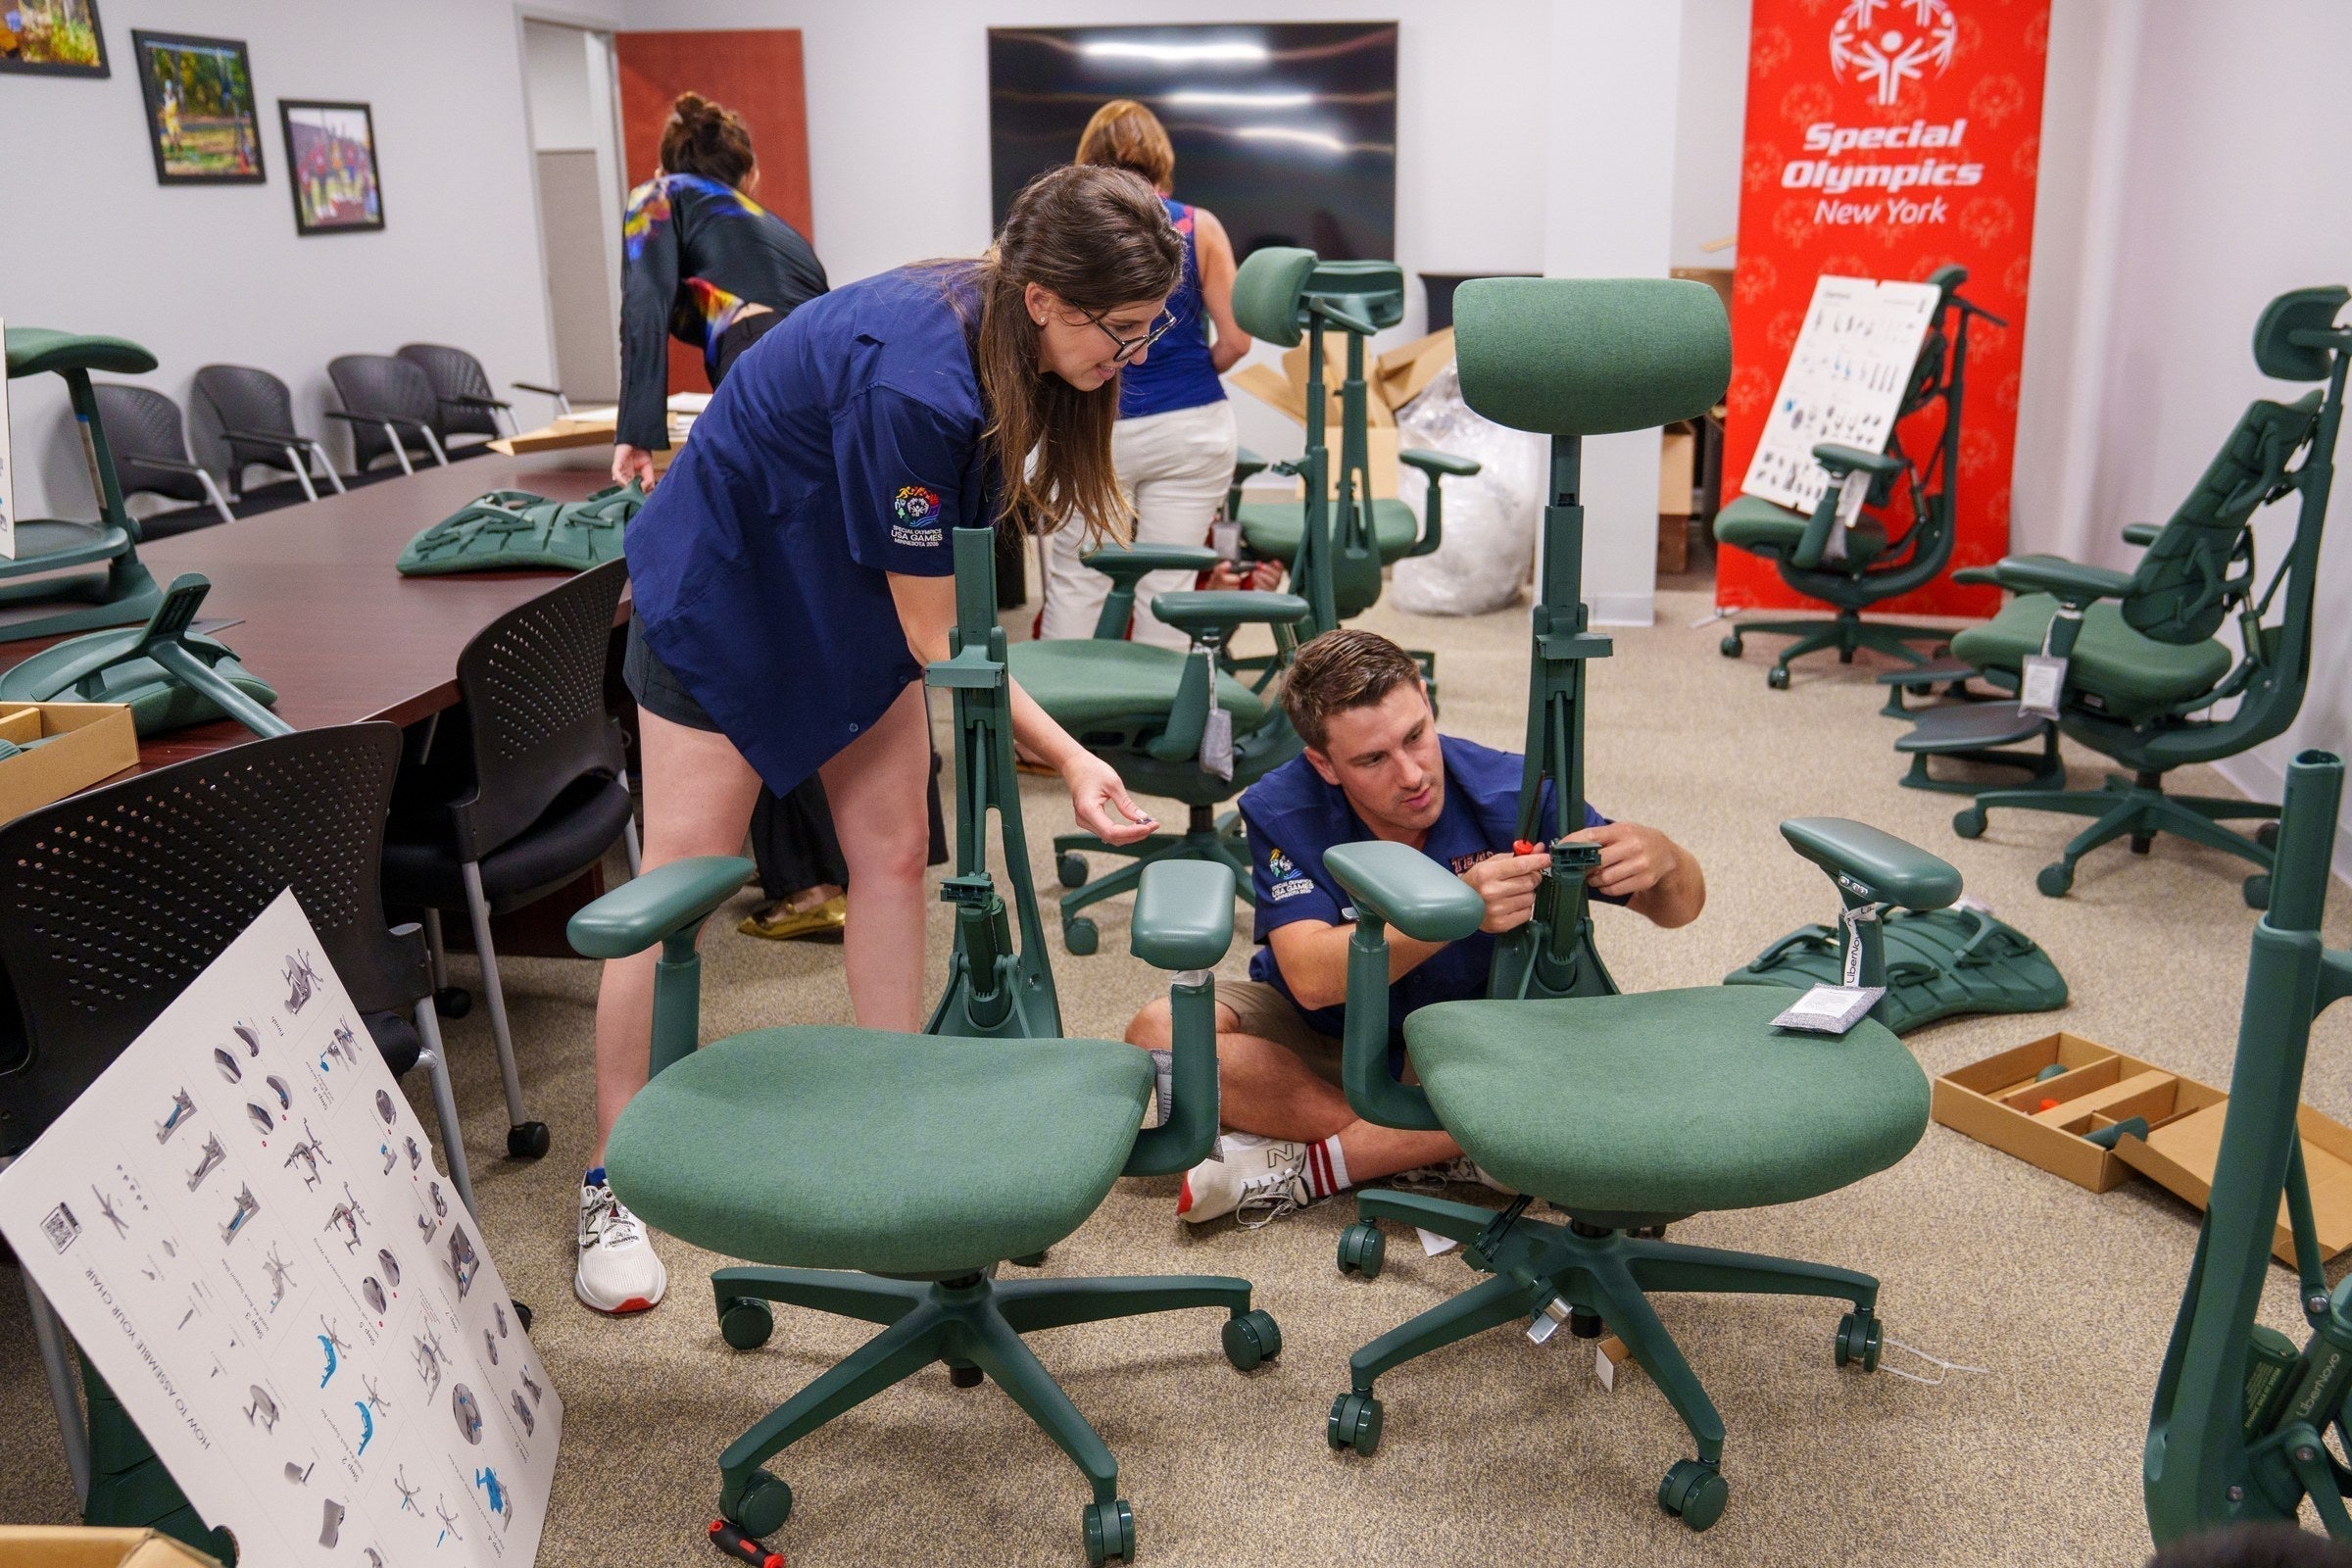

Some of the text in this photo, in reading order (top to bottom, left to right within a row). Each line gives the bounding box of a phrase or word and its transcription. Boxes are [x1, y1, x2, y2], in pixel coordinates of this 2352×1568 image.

[1803, 118, 1968, 157] Special
[1781, 158, 1985, 194] Olympics
[1813, 195, 1949, 225] New York
[892, 529, 943, 542] USA GAMES
[893, 524, 913, 535] SPECIAL
[894, 538, 925, 547] MINNESOTA
[1272, 882, 1314, 898] USA GAMES
[251, 1319, 263, 1339] Step
[364, 1328, 375, 1346] Step
[85, 1269, 210, 1449] HOW TO ASSEMBLE YOUR CHAIR
[2295, 1353, 2340, 1418] LiberNovo
[347, 1463, 359, 1482] Step
